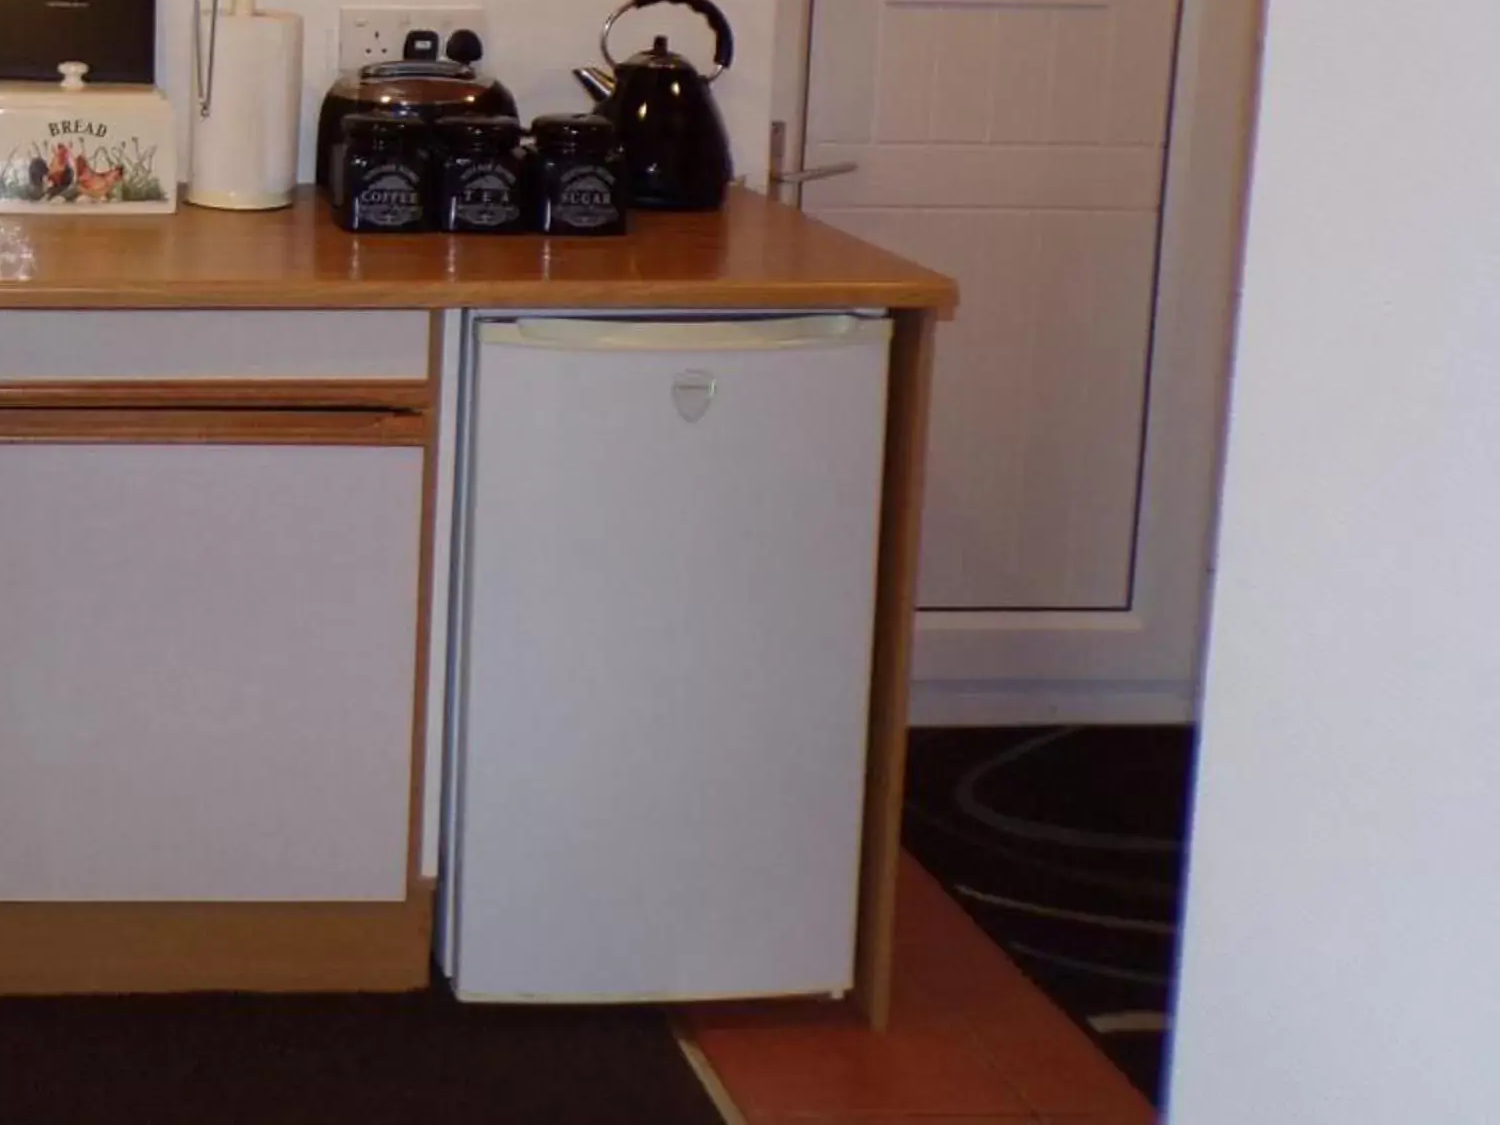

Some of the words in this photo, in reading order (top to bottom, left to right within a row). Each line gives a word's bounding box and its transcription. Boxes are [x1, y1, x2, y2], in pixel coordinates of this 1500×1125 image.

[48, 119, 109, 138] BREAD
[361, 190, 420, 205] COFFEE
[561, 191, 612, 206] SUGAR
